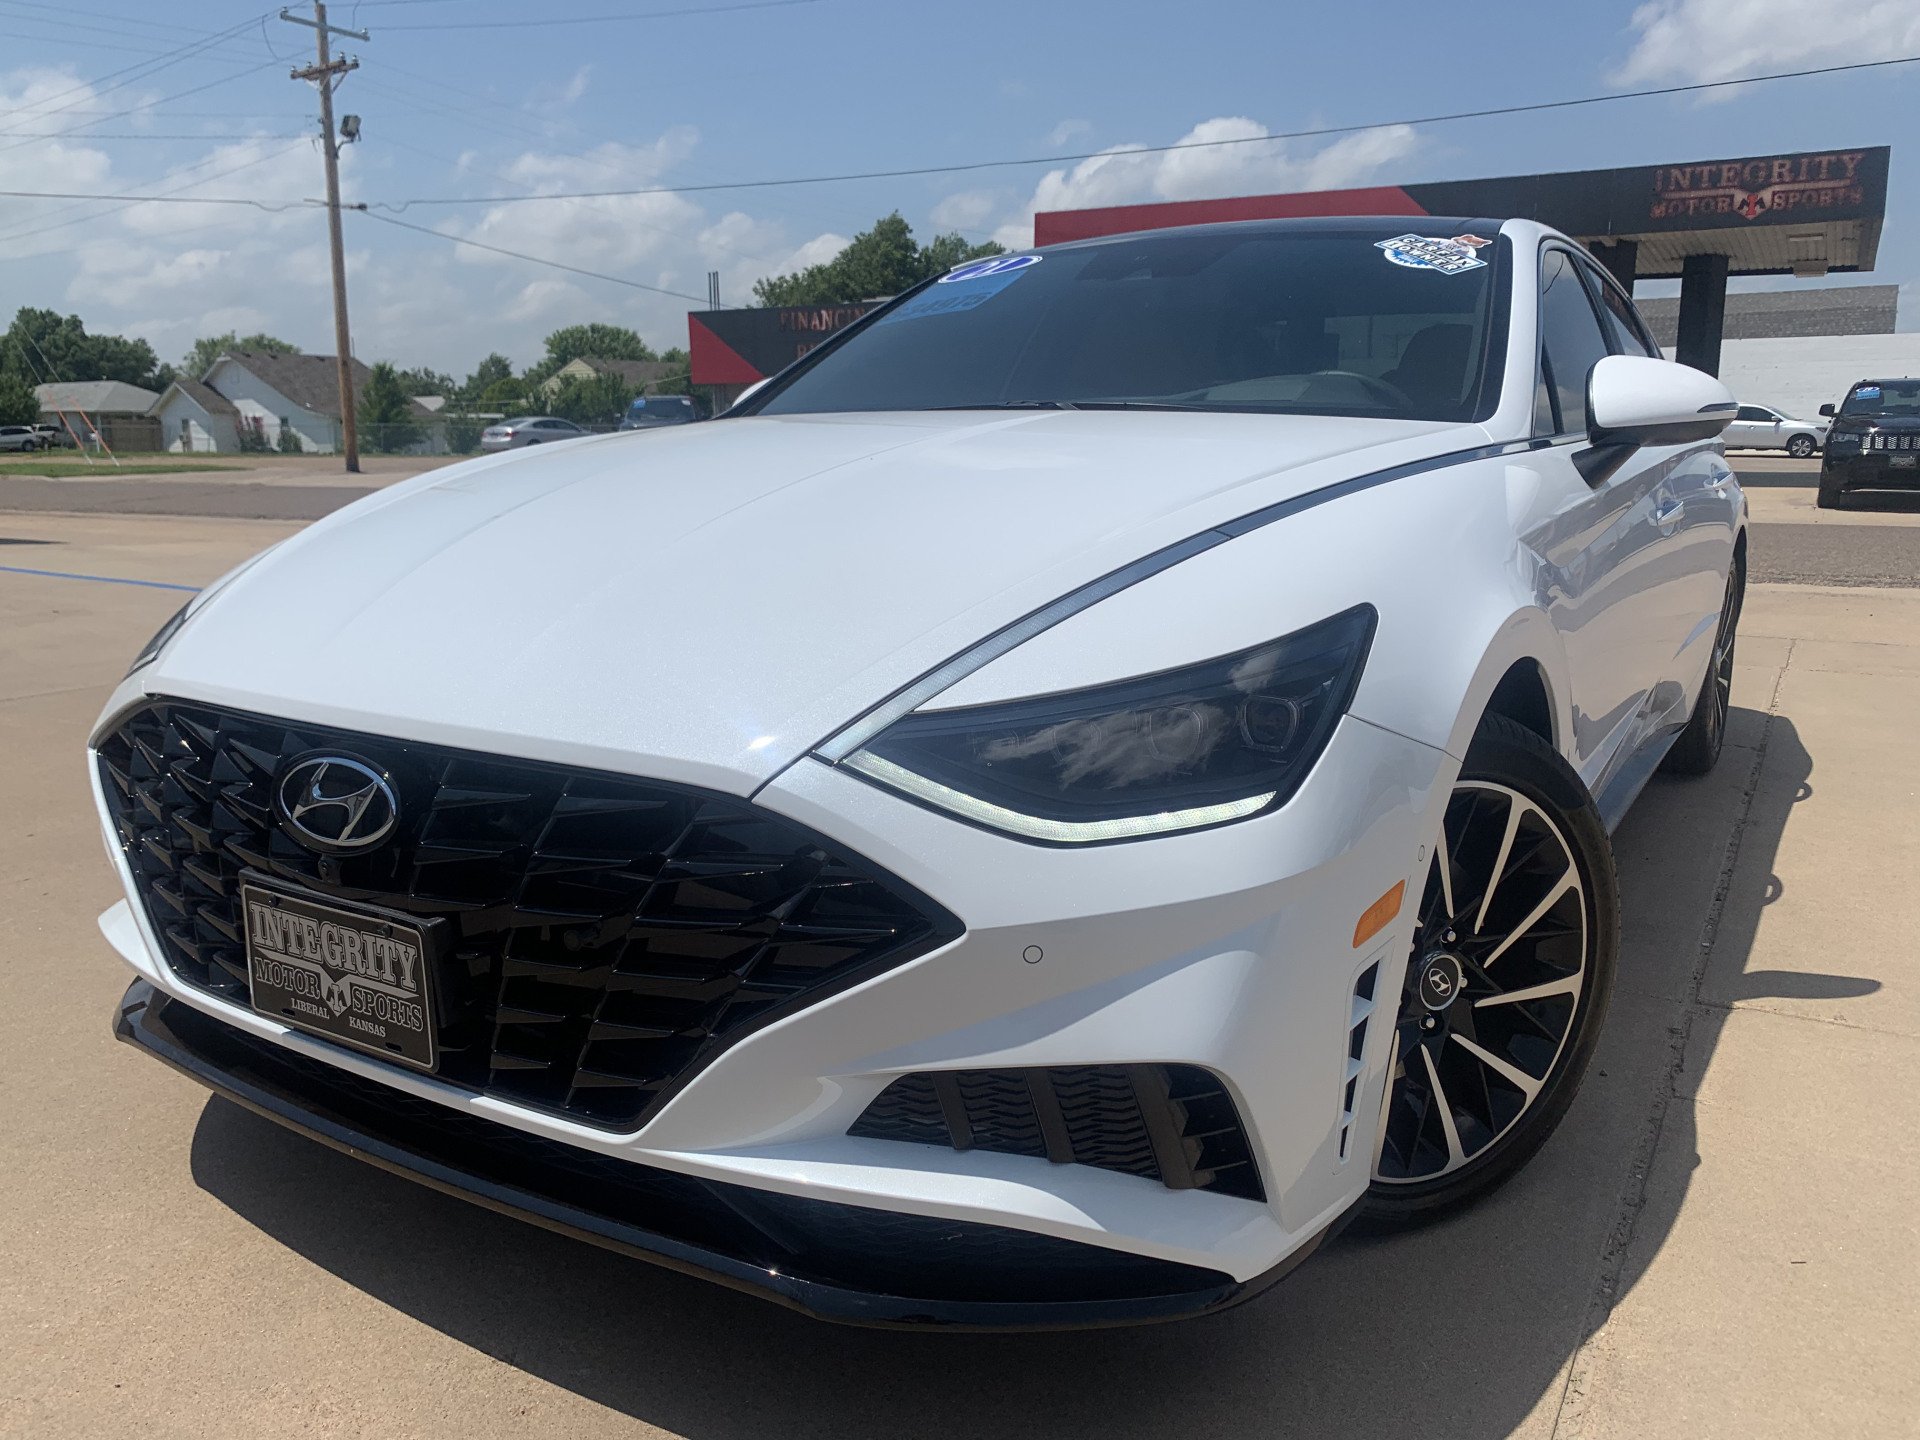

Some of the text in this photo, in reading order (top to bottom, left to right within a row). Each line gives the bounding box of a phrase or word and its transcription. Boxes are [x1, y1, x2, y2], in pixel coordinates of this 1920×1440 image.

[1654, 153, 1865, 192] INTEGRITY
[1650, 187, 1864, 219] MOTOR SPORTS
[250, 901, 417, 992] INTEGRITY
[254, 957, 424, 1032] MOTOR SPORTS
[291, 998, 330, 1020] LIBERAL
[349, 1016, 387, 1038] KANSAS
